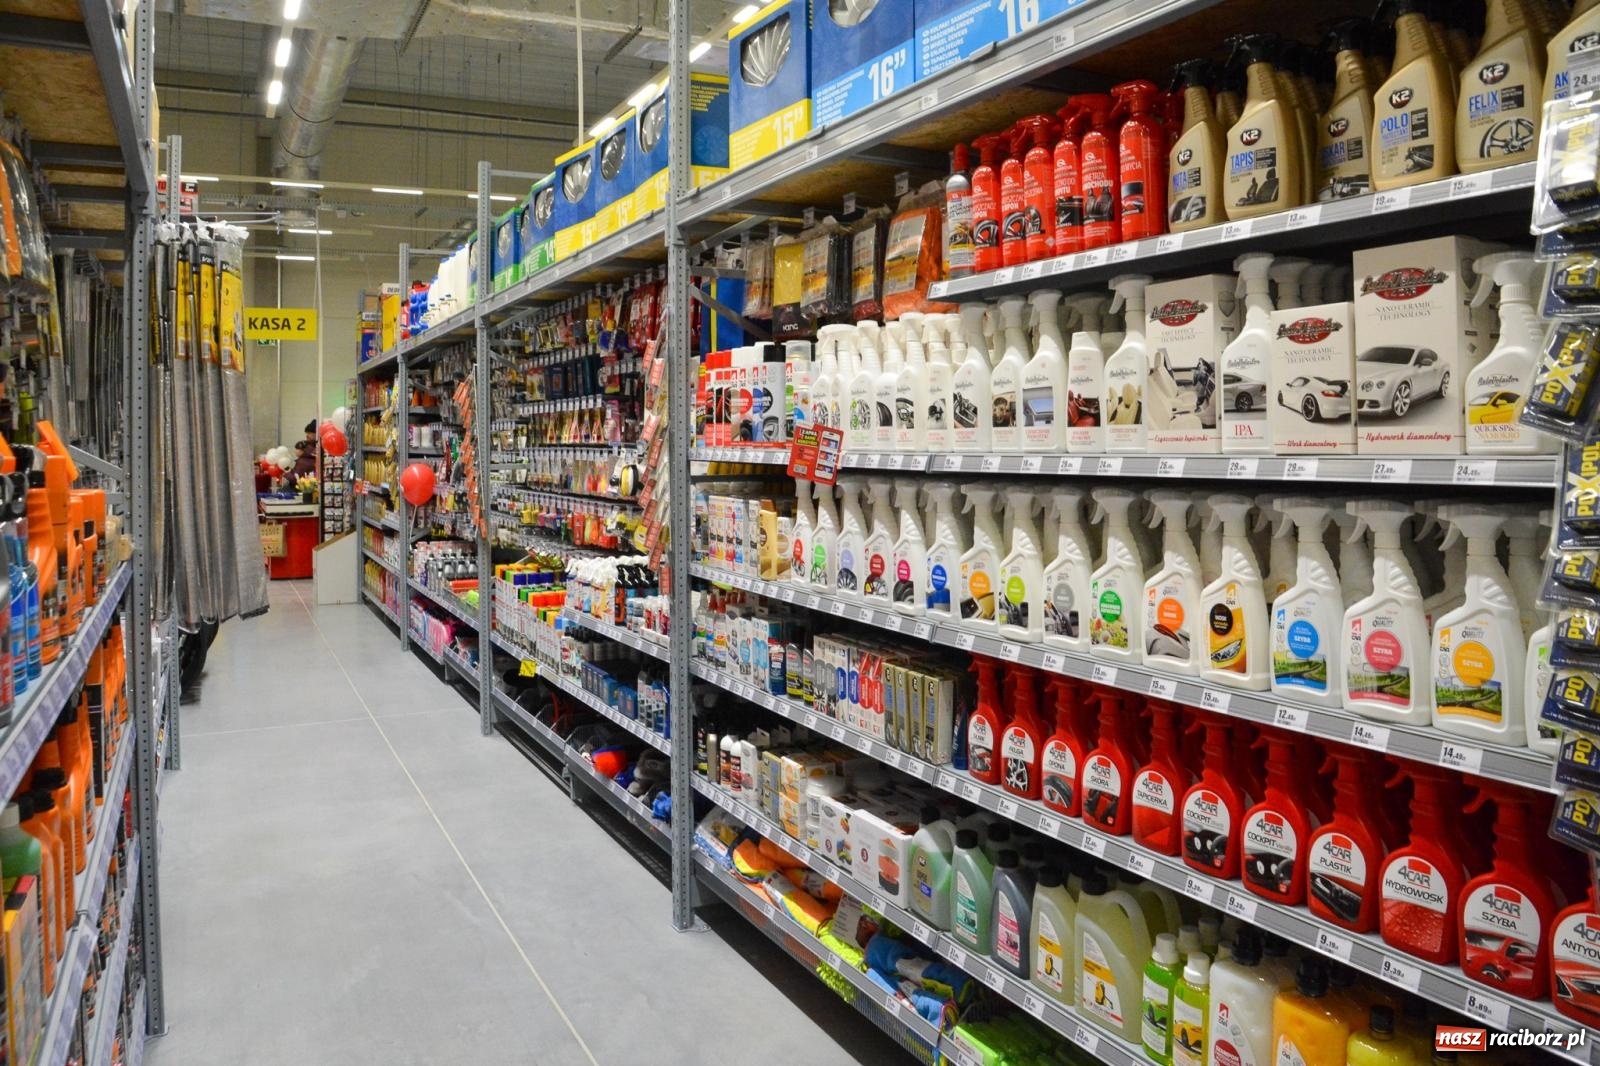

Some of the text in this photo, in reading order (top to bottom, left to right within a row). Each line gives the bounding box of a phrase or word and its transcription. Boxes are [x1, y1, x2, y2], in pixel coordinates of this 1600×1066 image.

[1481, 64, 1505, 80] K2
[1391, 91, 1411, 104] K2
[1468, 91, 1499, 113] FELIX
[1380, 113, 1409, 134] POLO
[1242, 129, 1260, 143] K2
[1230, 151, 1254, 170] TAPIS
[248, 317, 306, 331] KASA 2
[1379, 310, 1432, 321] TECHNOLOGY
[1234, 424, 1253, 436] IPA
[1474, 424, 1498, 433] QUICK
[1090, 762, 1111, 778] 4CAR
[1142, 777, 1163, 794] 4CAR
[1136, 789, 1168, 807] TAPICERKA
[1194, 796, 1218, 815] 4CAR
[1186, 808, 1211, 824] COCKPIT
[1256, 818, 1284, 837] 4CAR
[1247, 831, 1276, 847] COCKPIT
[1323, 841, 1352, 863] 4CAR
[1319, 856, 1353, 875] PLASTIK
[1398, 865, 1431, 887] 4CAR
[1385, 878, 1444, 904] HYDROWOSK
[1482, 892, 1521, 917] 4CAR
[1481, 911, 1518, 930] SZYBA
